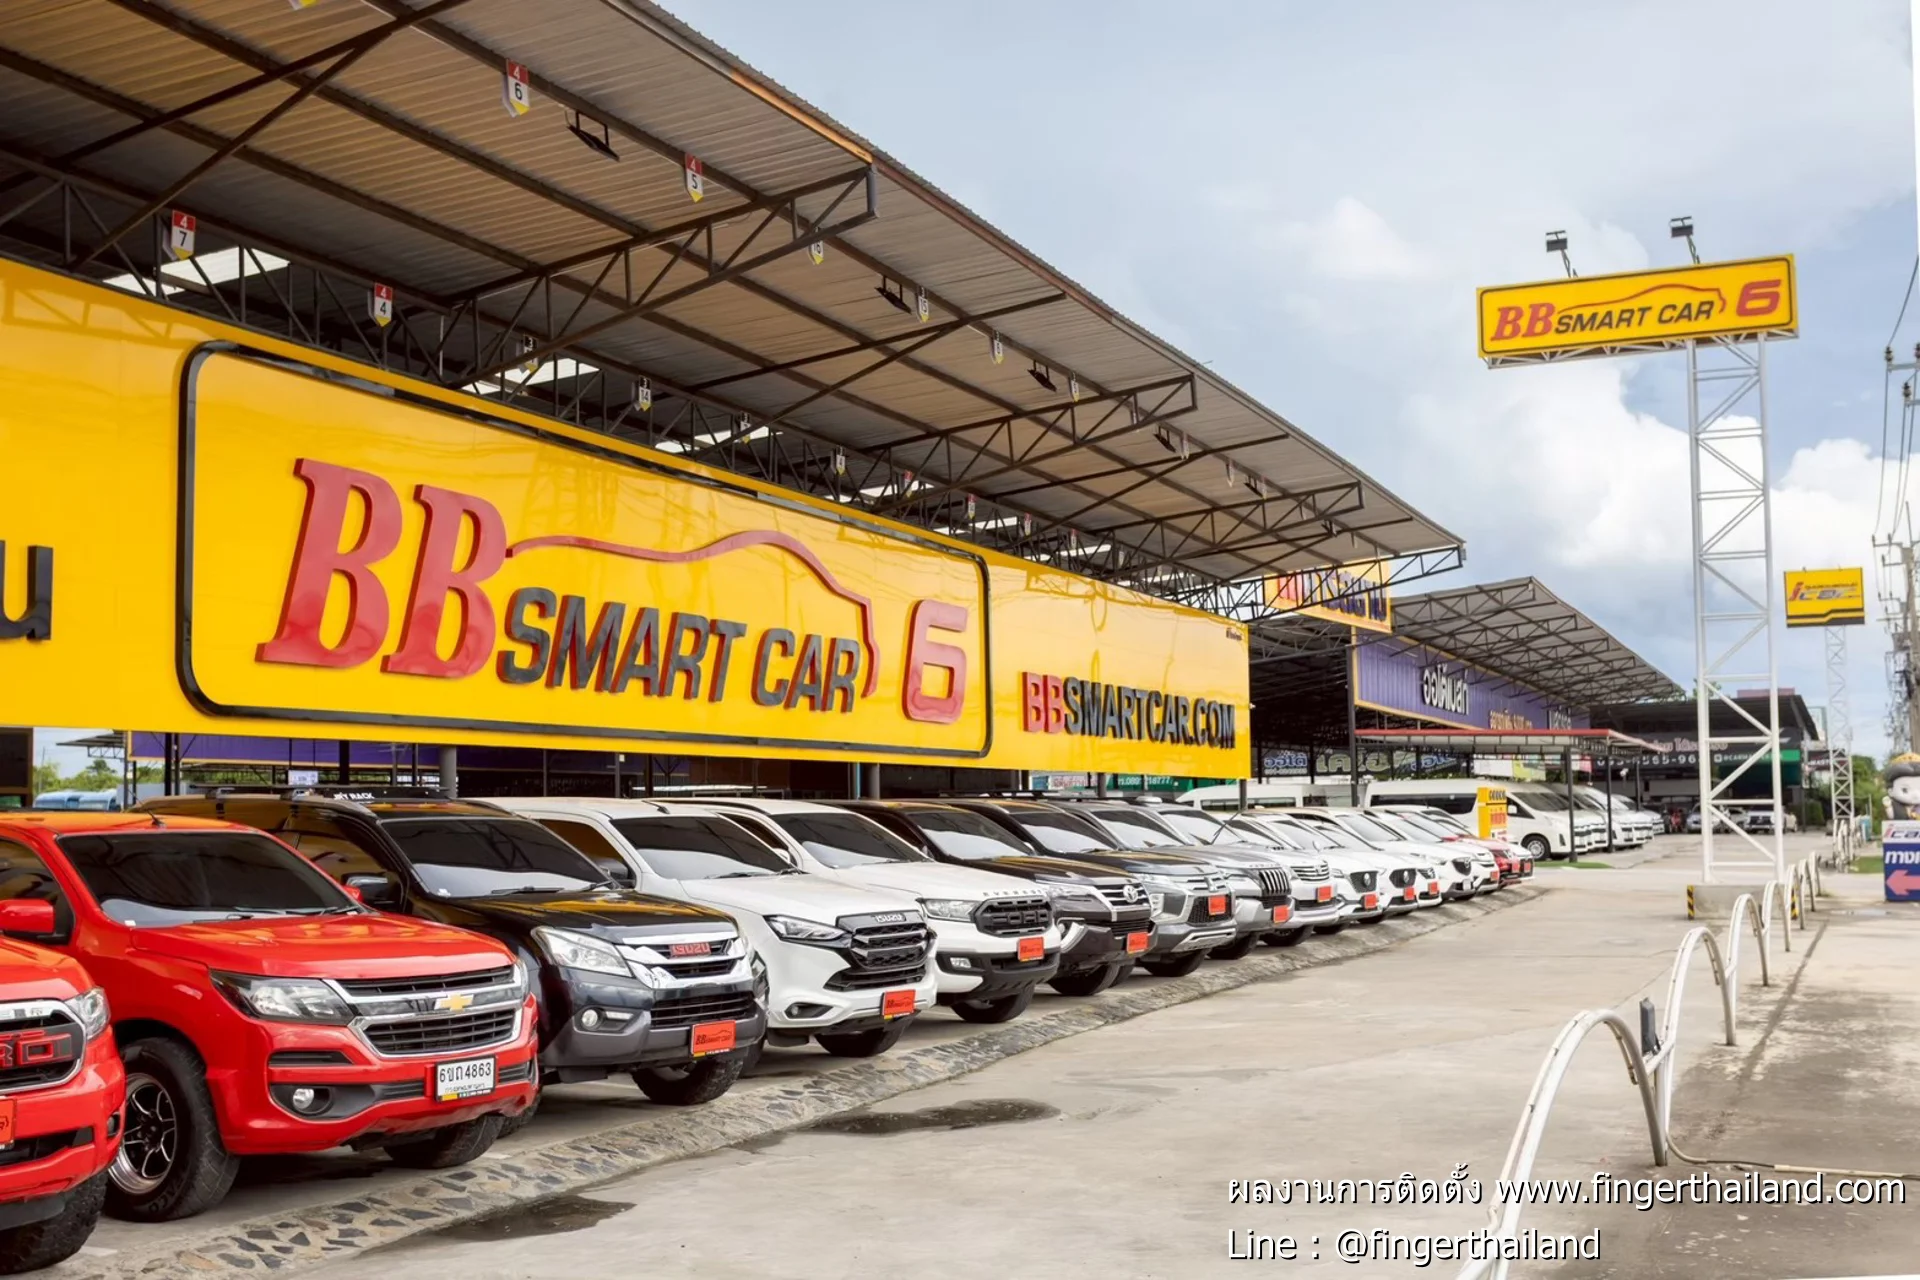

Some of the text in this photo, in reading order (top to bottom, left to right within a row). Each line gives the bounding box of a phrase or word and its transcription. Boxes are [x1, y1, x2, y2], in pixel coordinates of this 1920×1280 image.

[513, 65, 521, 80] 4
[514, 82, 523, 101] 6
[692, 173, 698, 189] 5
[180, 215, 189, 229] 4
[179, 230, 188, 247] 7
[379, 301, 387, 316] 4
[1490, 279, 1782, 341] BB SMART CAR 6
[255, 458, 968, 724] BB SMART CAR 6
[1021, 671, 1236, 750] BBSMARTCAR.COM
[670, 942, 711, 955] ISUZU
